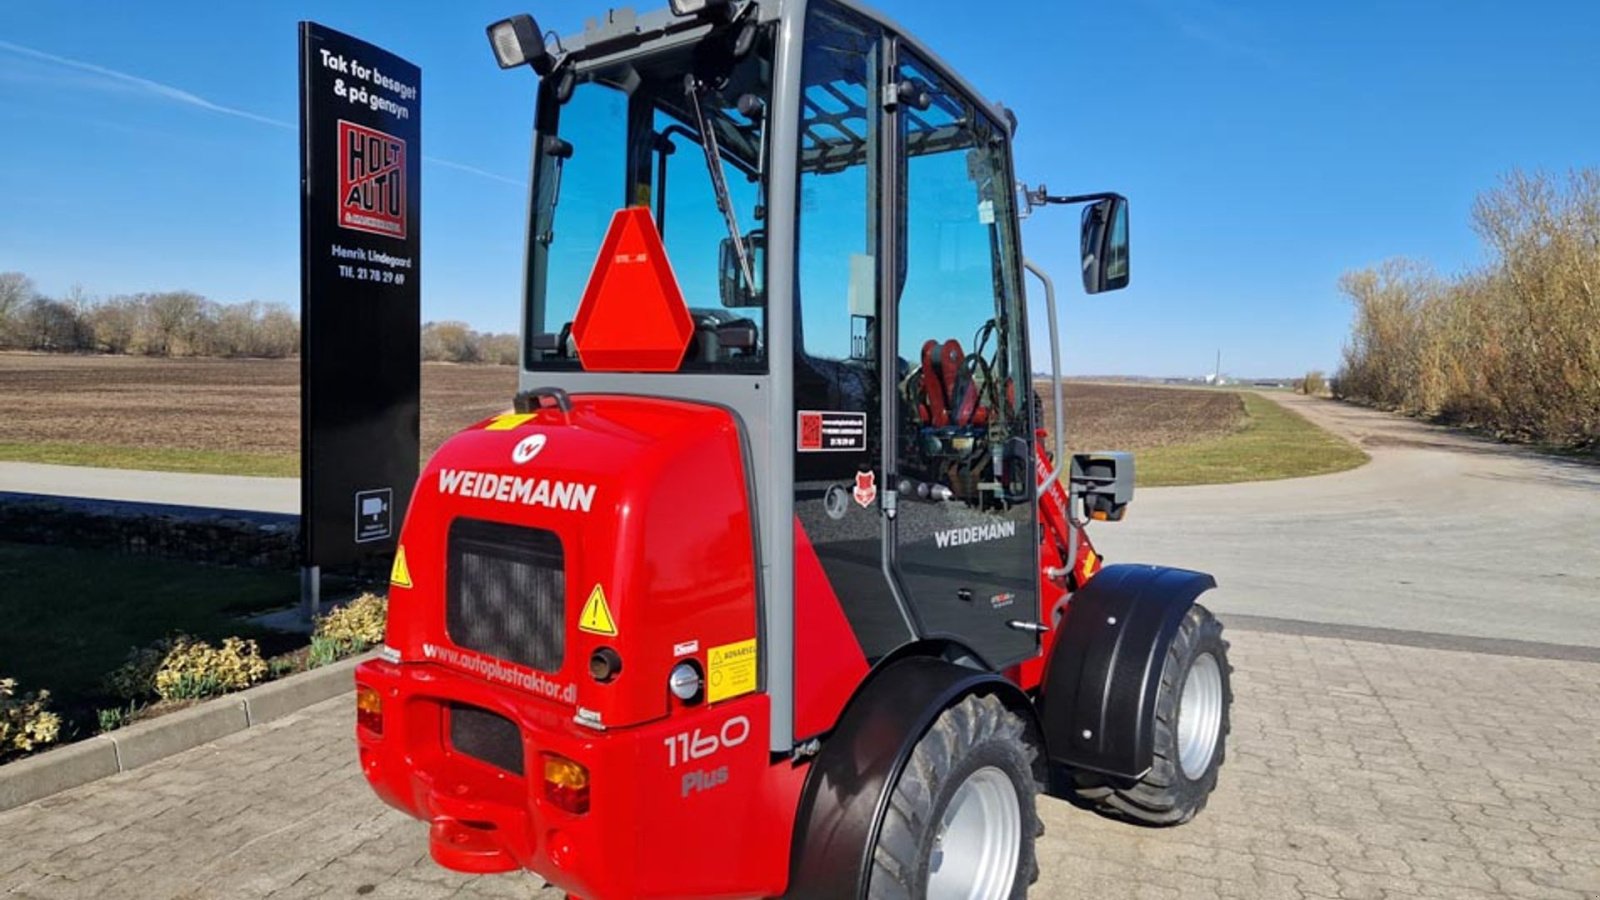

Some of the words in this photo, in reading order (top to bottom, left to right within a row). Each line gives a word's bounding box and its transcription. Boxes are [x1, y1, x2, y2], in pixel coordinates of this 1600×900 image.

[320, 48, 347, 74] Tak
[351, 60, 371, 80] for
[374, 67, 416, 101] besøget
[334, 78, 347, 97] &
[349, 86, 368, 103] på
[370, 94, 409, 119] gensyn
[347, 129, 401, 184] HOLT
[345, 168, 401, 217] AUTO
[332, 245, 366, 261] Henrik
[357, 267, 368, 280] 21
[439, 468, 597, 513] WEIDEMANN
[935, 520, 1016, 549] WEIDEMANN
[664, 715, 750, 767] 1160
[682, 765, 729, 798] Plus
